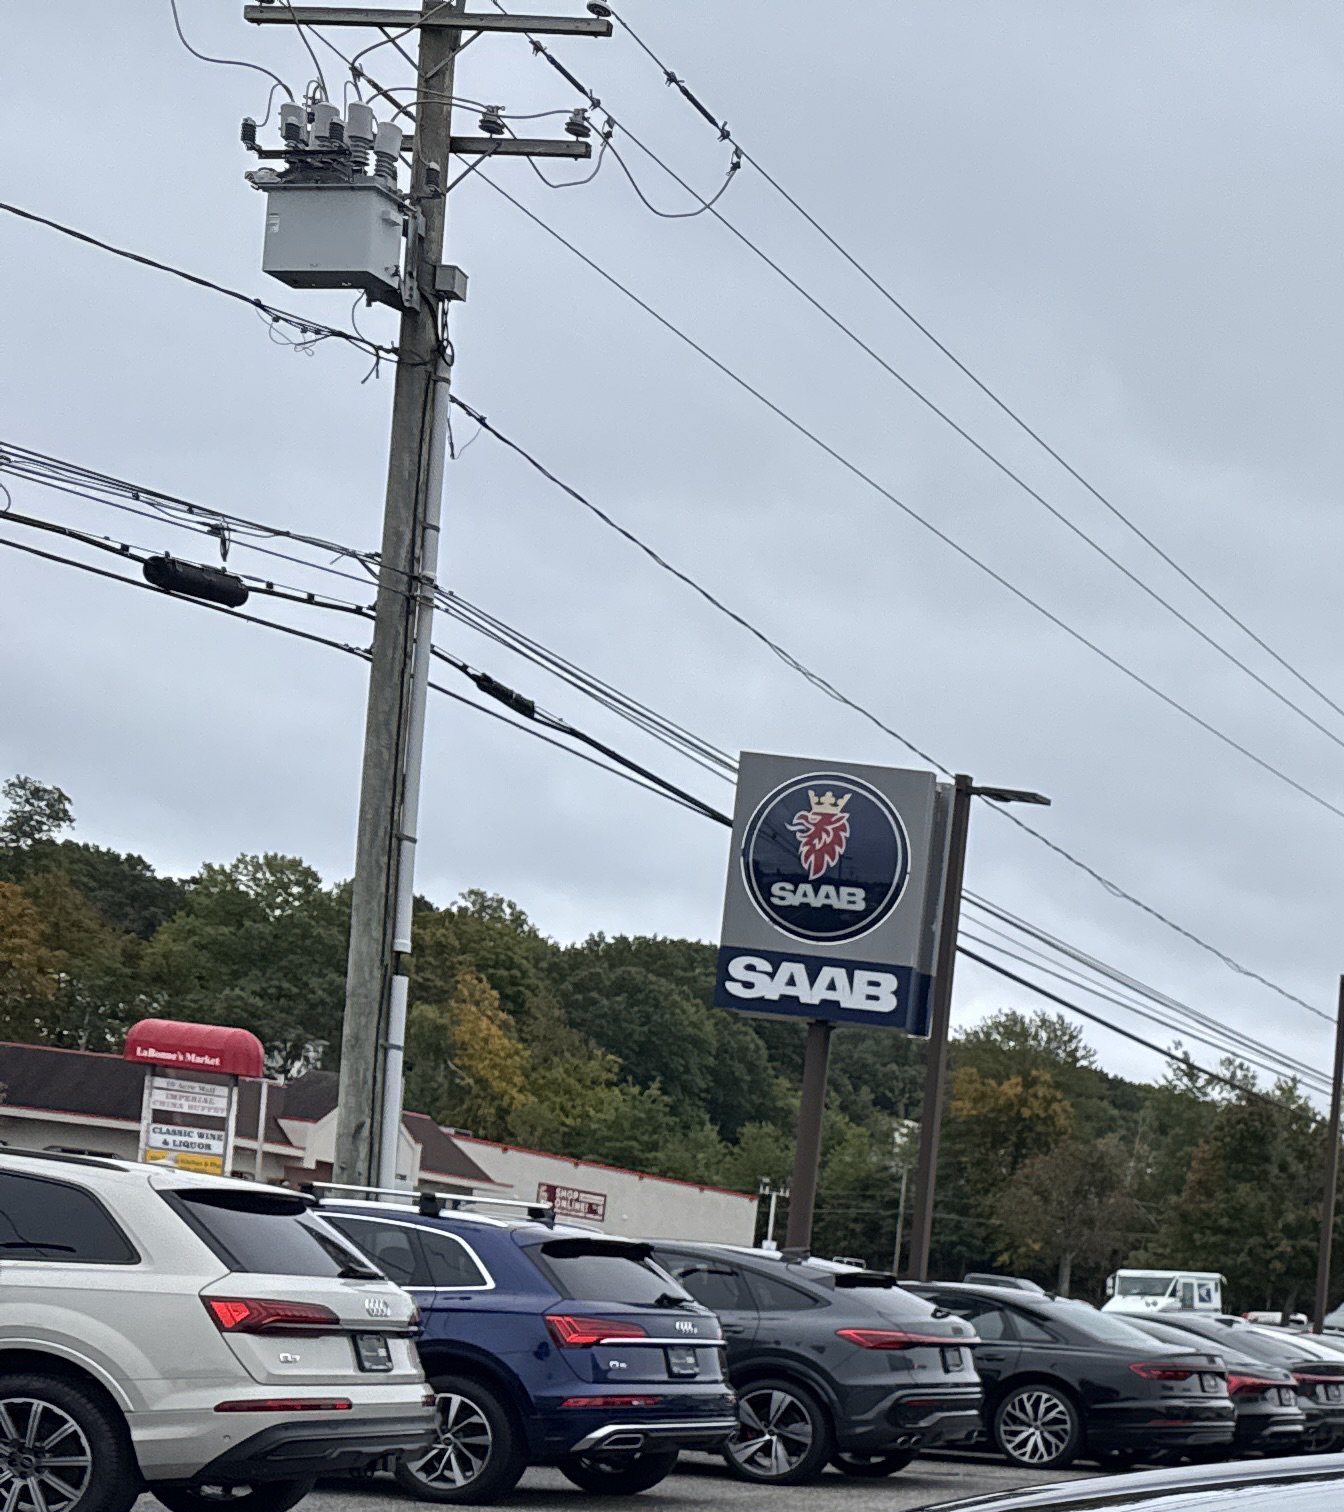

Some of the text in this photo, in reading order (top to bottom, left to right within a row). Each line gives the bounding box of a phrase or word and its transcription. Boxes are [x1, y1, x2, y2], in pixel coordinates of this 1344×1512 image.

[770, 881, 866, 912] SAAB
[724, 955, 899, 1013] SAAB
[185, 1052, 221, 1066] Market
[152, 1126, 224, 1143] CLASSIC WINE
[161, 1138, 213, 1152] & LIQUOR
[555, 1187, 580, 1200] SHOP
